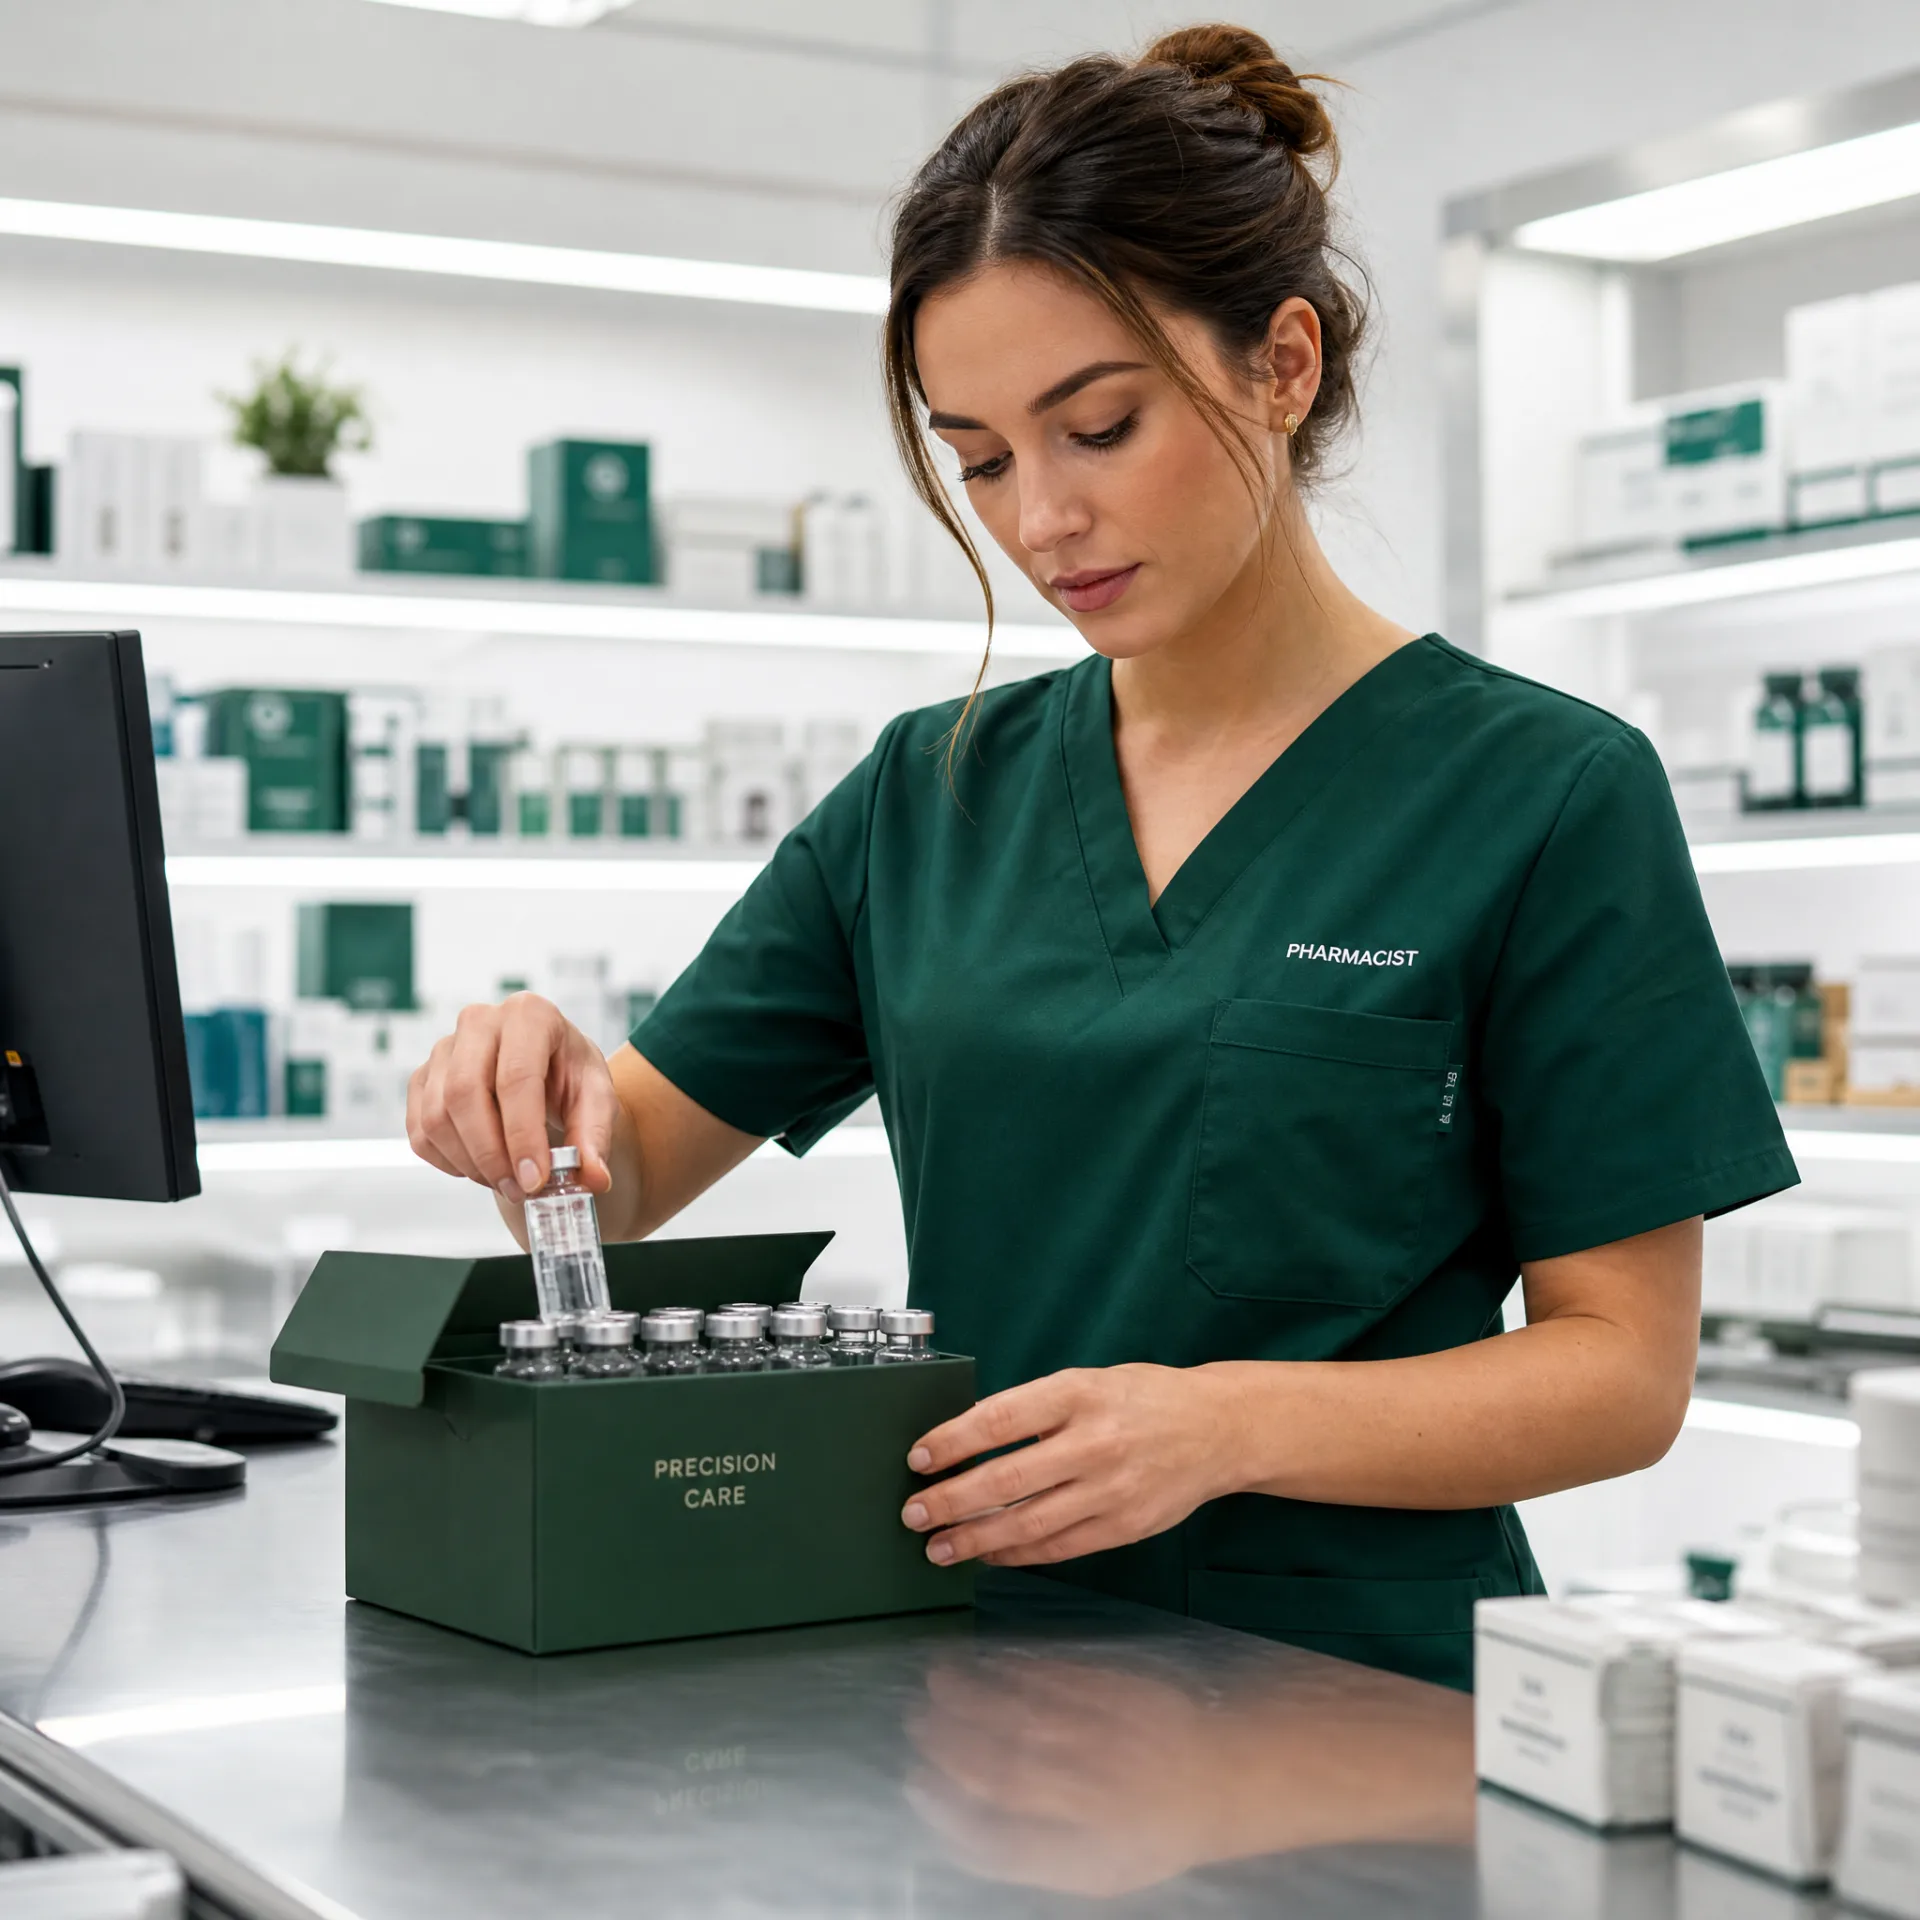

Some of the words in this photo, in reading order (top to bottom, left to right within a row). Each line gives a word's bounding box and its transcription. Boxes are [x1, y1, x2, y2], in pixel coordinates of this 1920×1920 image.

[1286, 943, 1419, 967] PHARMACIST
[654, 1452, 777, 1479] PRECISION
[684, 1485, 746, 1509] CARE
